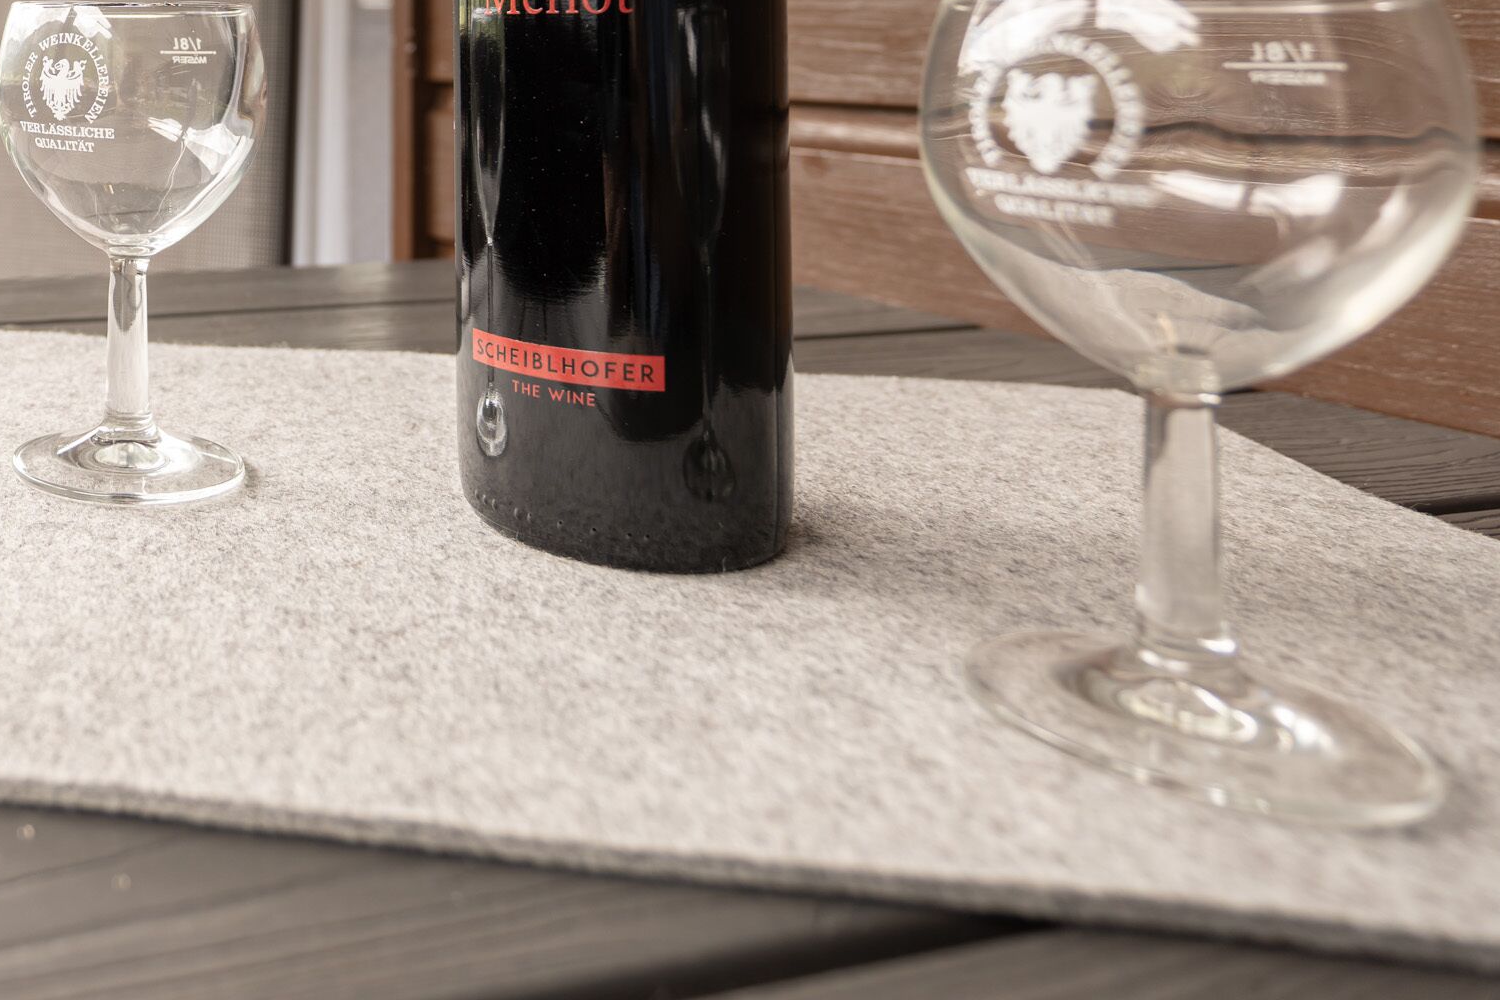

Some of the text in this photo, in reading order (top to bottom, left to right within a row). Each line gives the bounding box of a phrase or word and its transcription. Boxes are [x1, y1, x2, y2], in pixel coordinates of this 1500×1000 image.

[21, 32, 109, 124] TIROLER WEINKELLEREIEN
[20, 120, 115, 139] VERLÄSSLICHE
[35, 138, 94, 152] QUALITÄT
[477, 338, 655, 384] SCHEIBLHOFER
[512, 379, 596, 407] THE WINE
